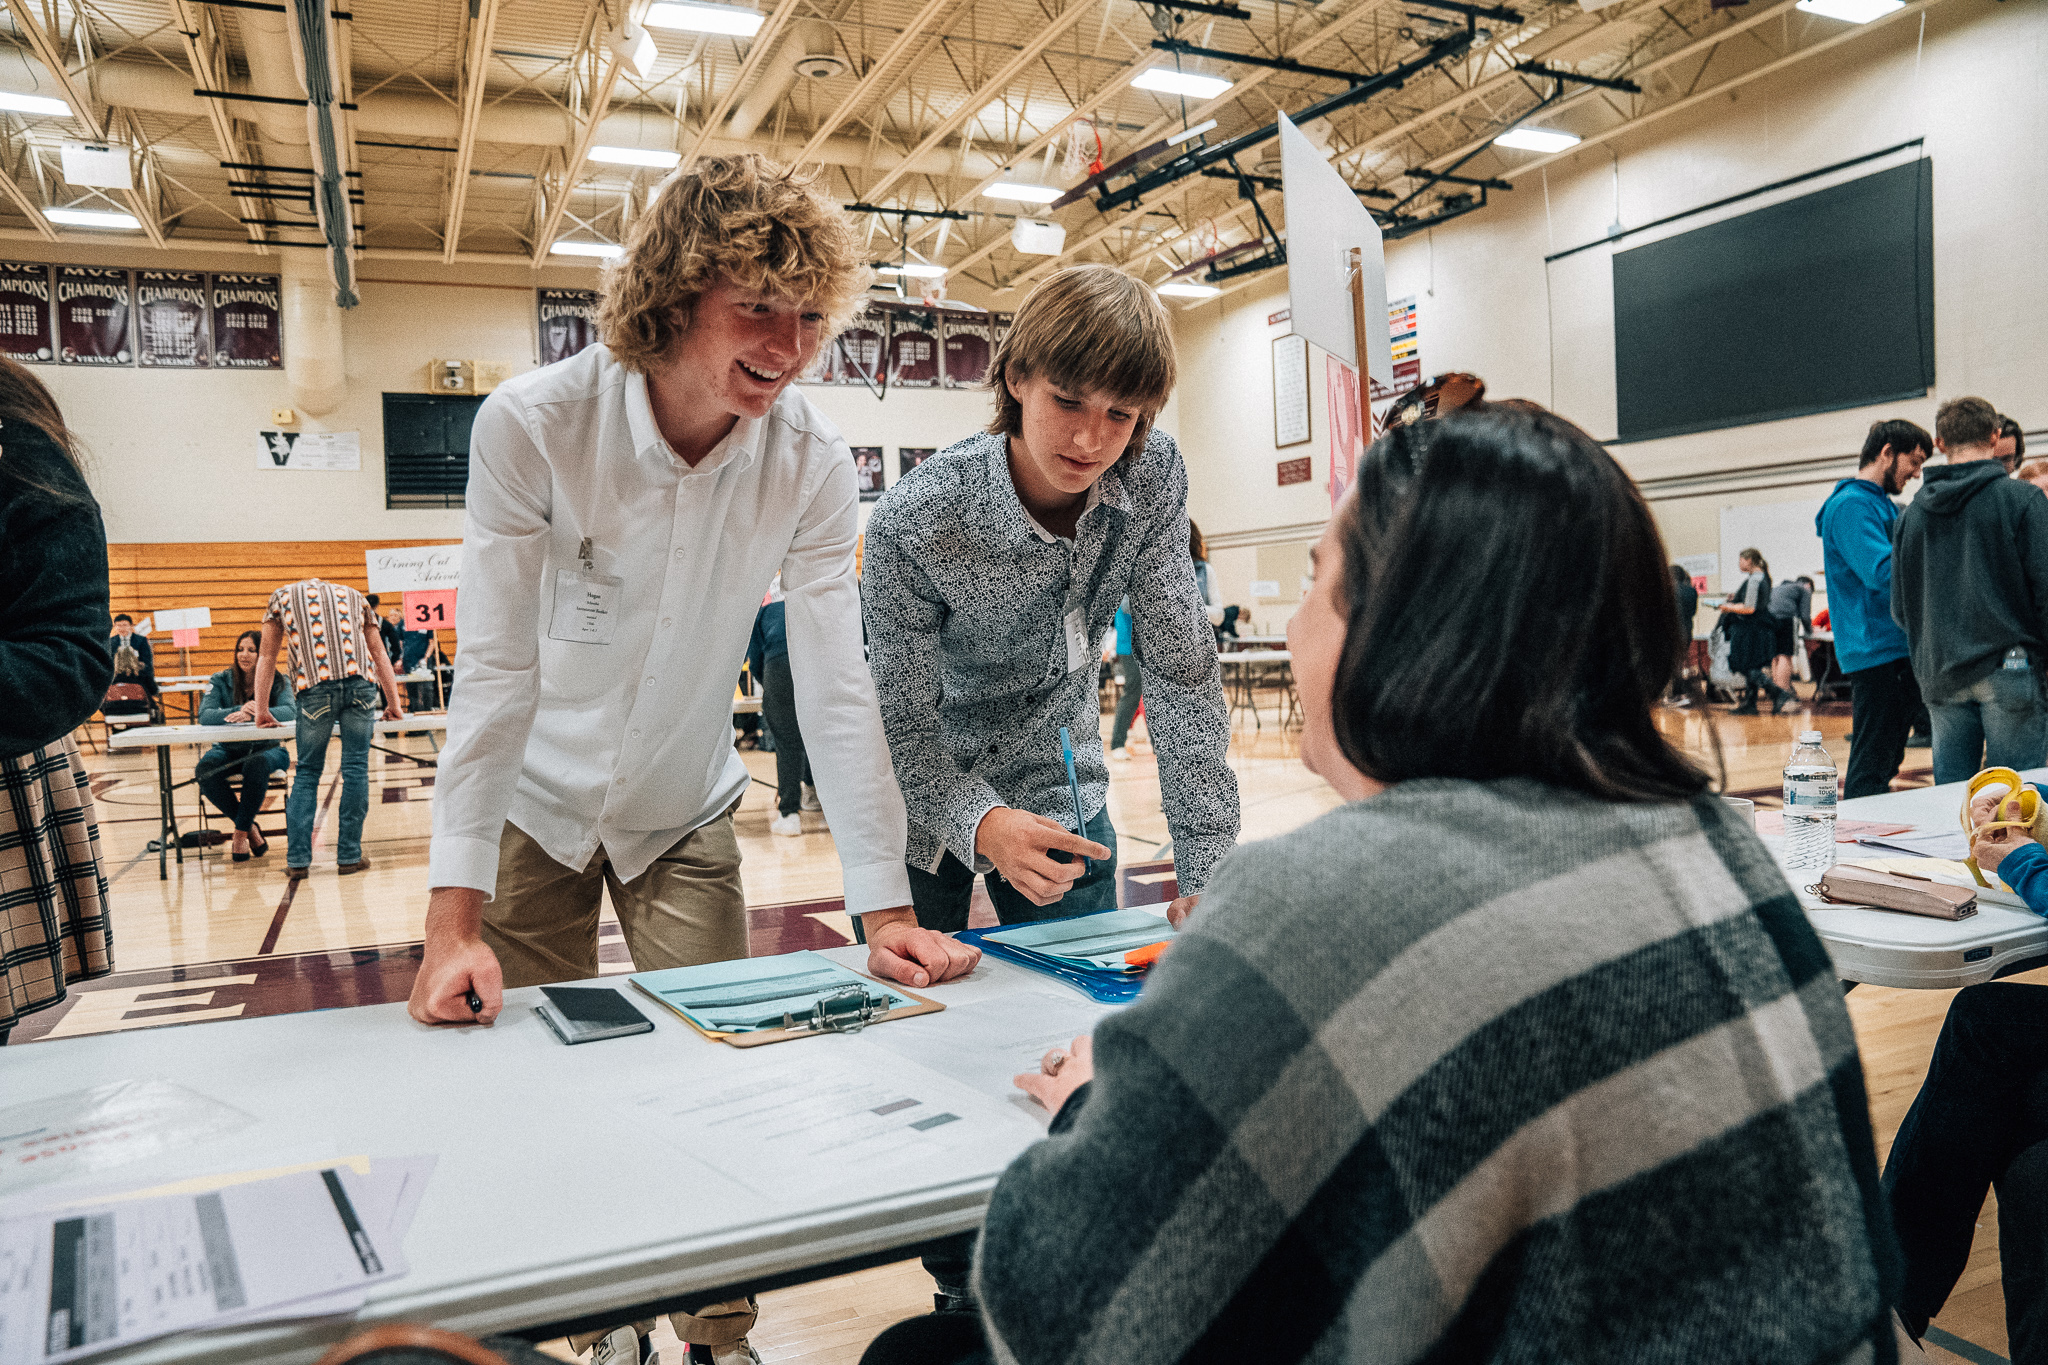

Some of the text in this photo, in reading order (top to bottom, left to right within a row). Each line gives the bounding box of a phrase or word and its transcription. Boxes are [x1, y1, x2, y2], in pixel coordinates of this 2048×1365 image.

[0, 264, 41, 273] VC
[64, 267, 121, 278] MVC
[143, 271, 198, 282] MVC
[219, 274, 272, 285] MVC
[0, 278, 49, 302] MPIONS
[58, 282, 129, 307] CHAMPIONS
[138, 286, 206, 310] CHAMPIONS
[213, 288, 279, 312] CHAMPIONS
[377, 555, 424, 571] Dining
[415, 603, 445, 622] 31
